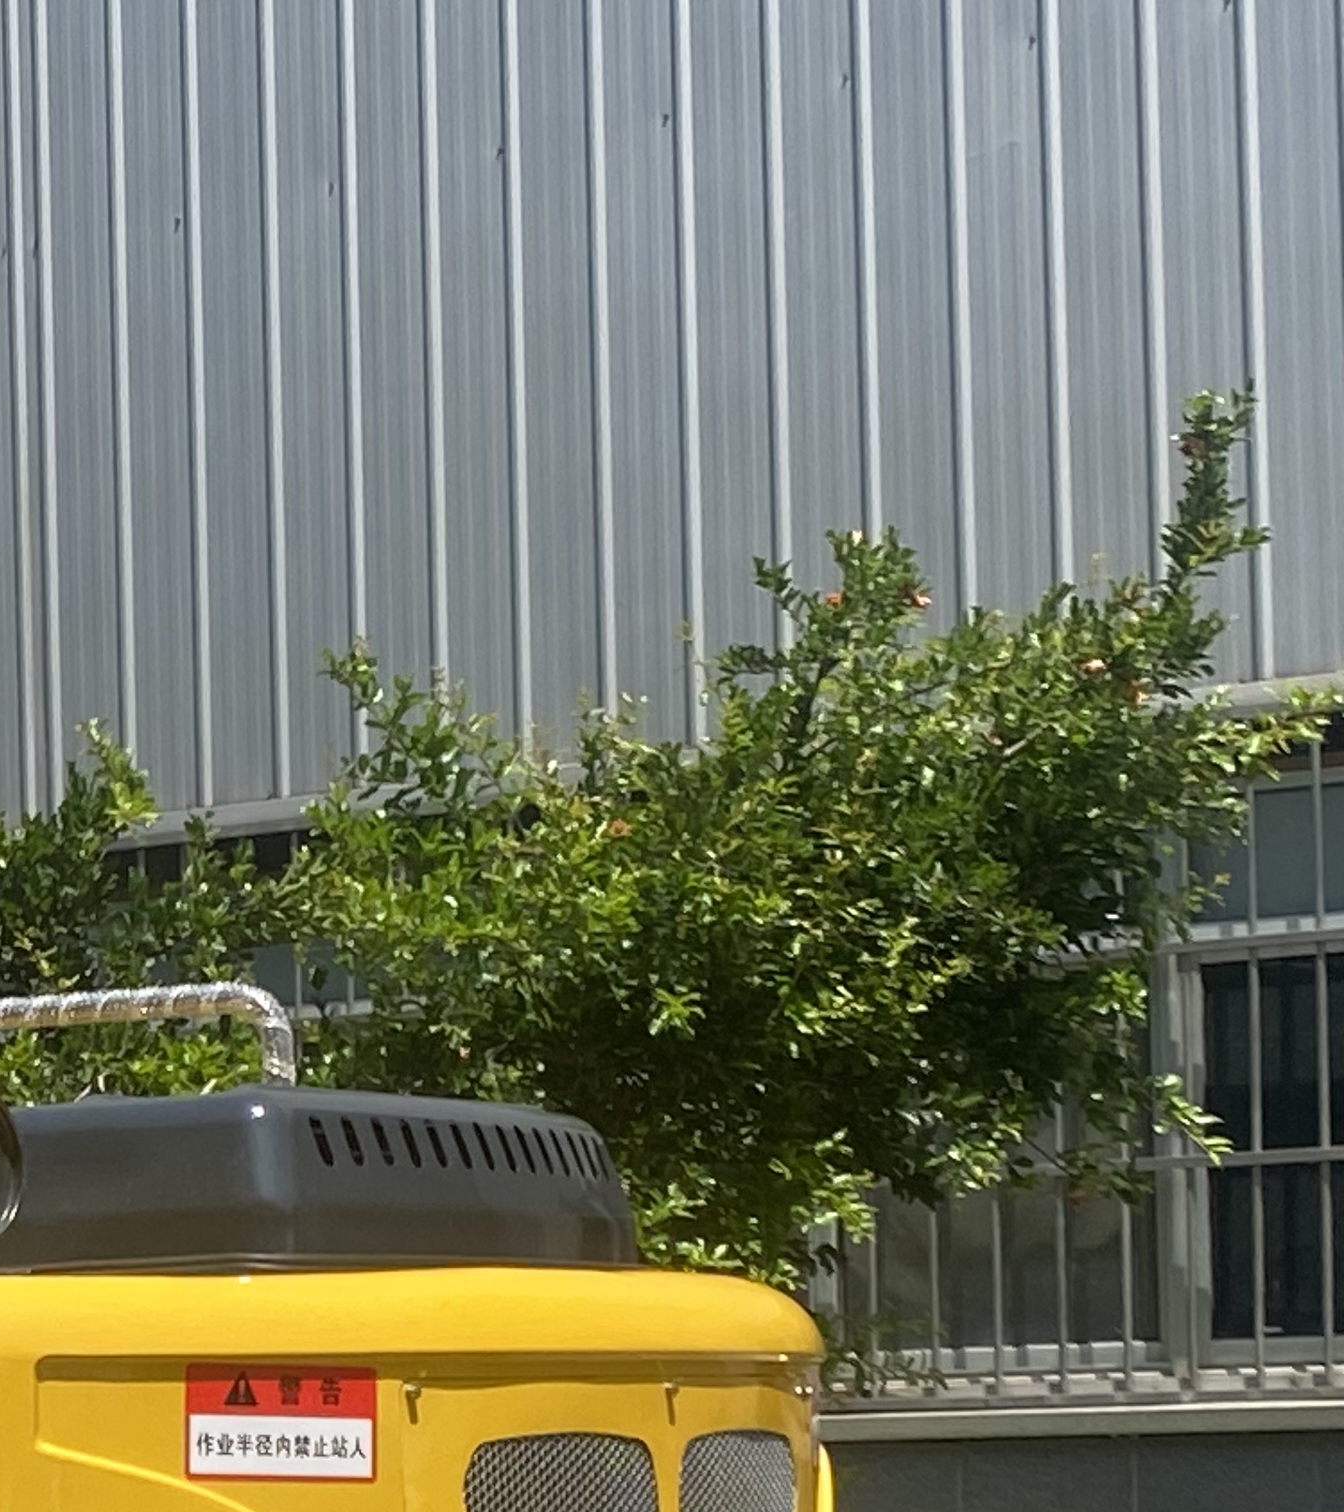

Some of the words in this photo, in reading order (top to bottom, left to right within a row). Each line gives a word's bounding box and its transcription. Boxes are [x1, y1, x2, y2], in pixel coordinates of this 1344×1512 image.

[278, 1374, 342, 1406] 警告
[196, 1431, 367, 1459] 作业半径内禁止站人
